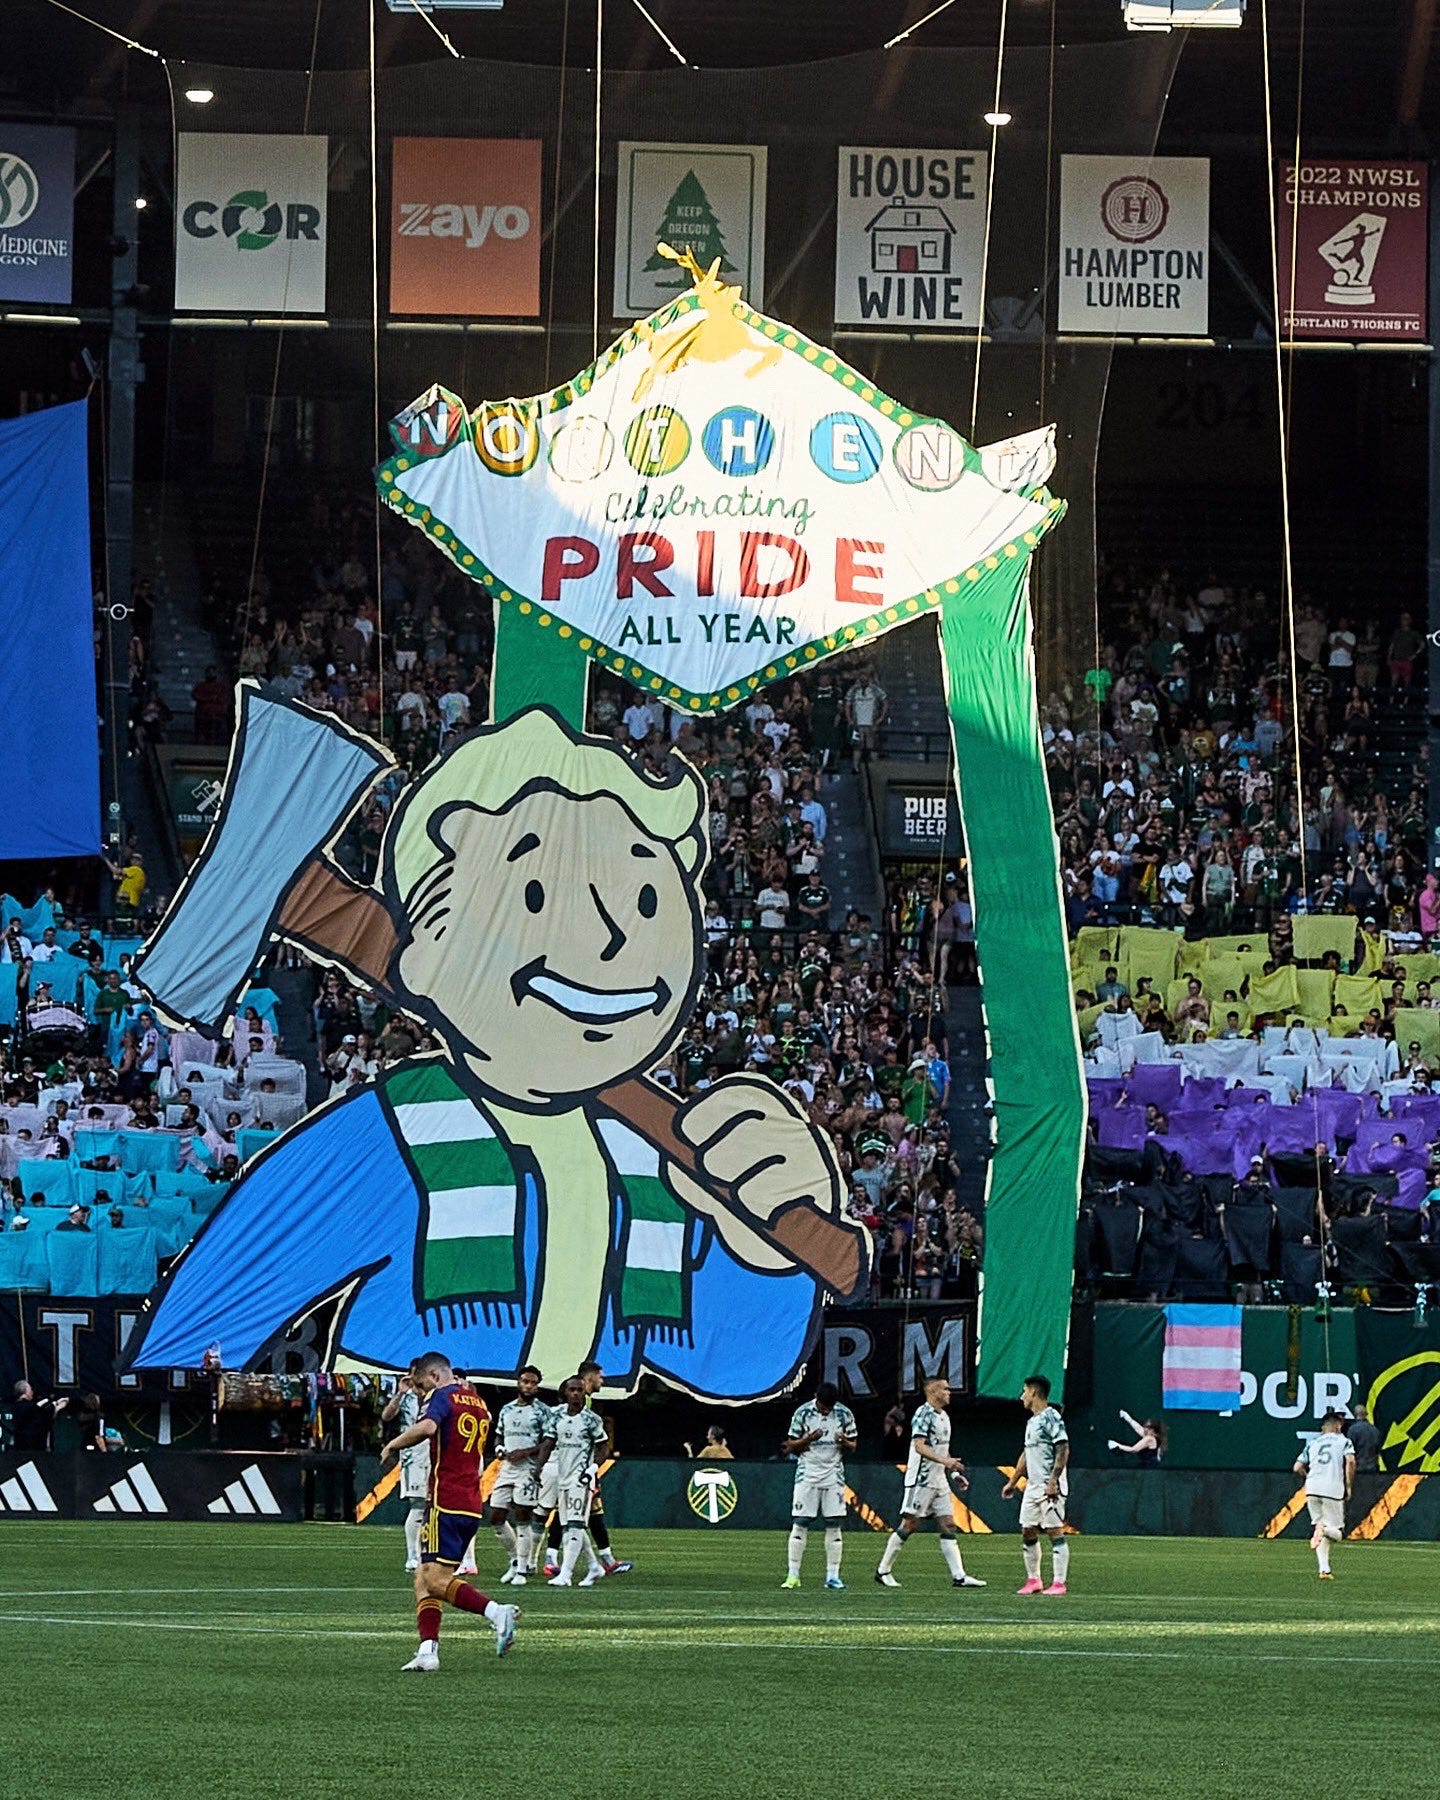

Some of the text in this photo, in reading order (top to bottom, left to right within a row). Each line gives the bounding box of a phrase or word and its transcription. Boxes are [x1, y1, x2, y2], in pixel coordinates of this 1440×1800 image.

[849, 154, 976, 200] HOUSE
[1286, 167, 1420, 186] 2022 NWSL
[1285, 189, 1421, 208] CHAMPIONS
[676, 205, 704, 218] KEEP
[398, 204, 531, 248] zayo
[668, 222, 711, 236] OREGON
[671, 240, 706, 253] GREN
[1064, 248, 1204, 280] HAMPTON
[858, 276, 963, 320] WINE
[1085, 281, 1181, 309] LUMBER
[1283, 317, 1421, 331] PORTLAND THORNS FC
[540, 530, 885, 606] PRIDE
[618, 613, 796, 647] ALL YEAR
[904, 797, 947, 819] PUB
[904, 818, 947, 836] BEER
[457, 1412, 489, 1455] 98
[1318, 1443, 1332, 1465] 5
